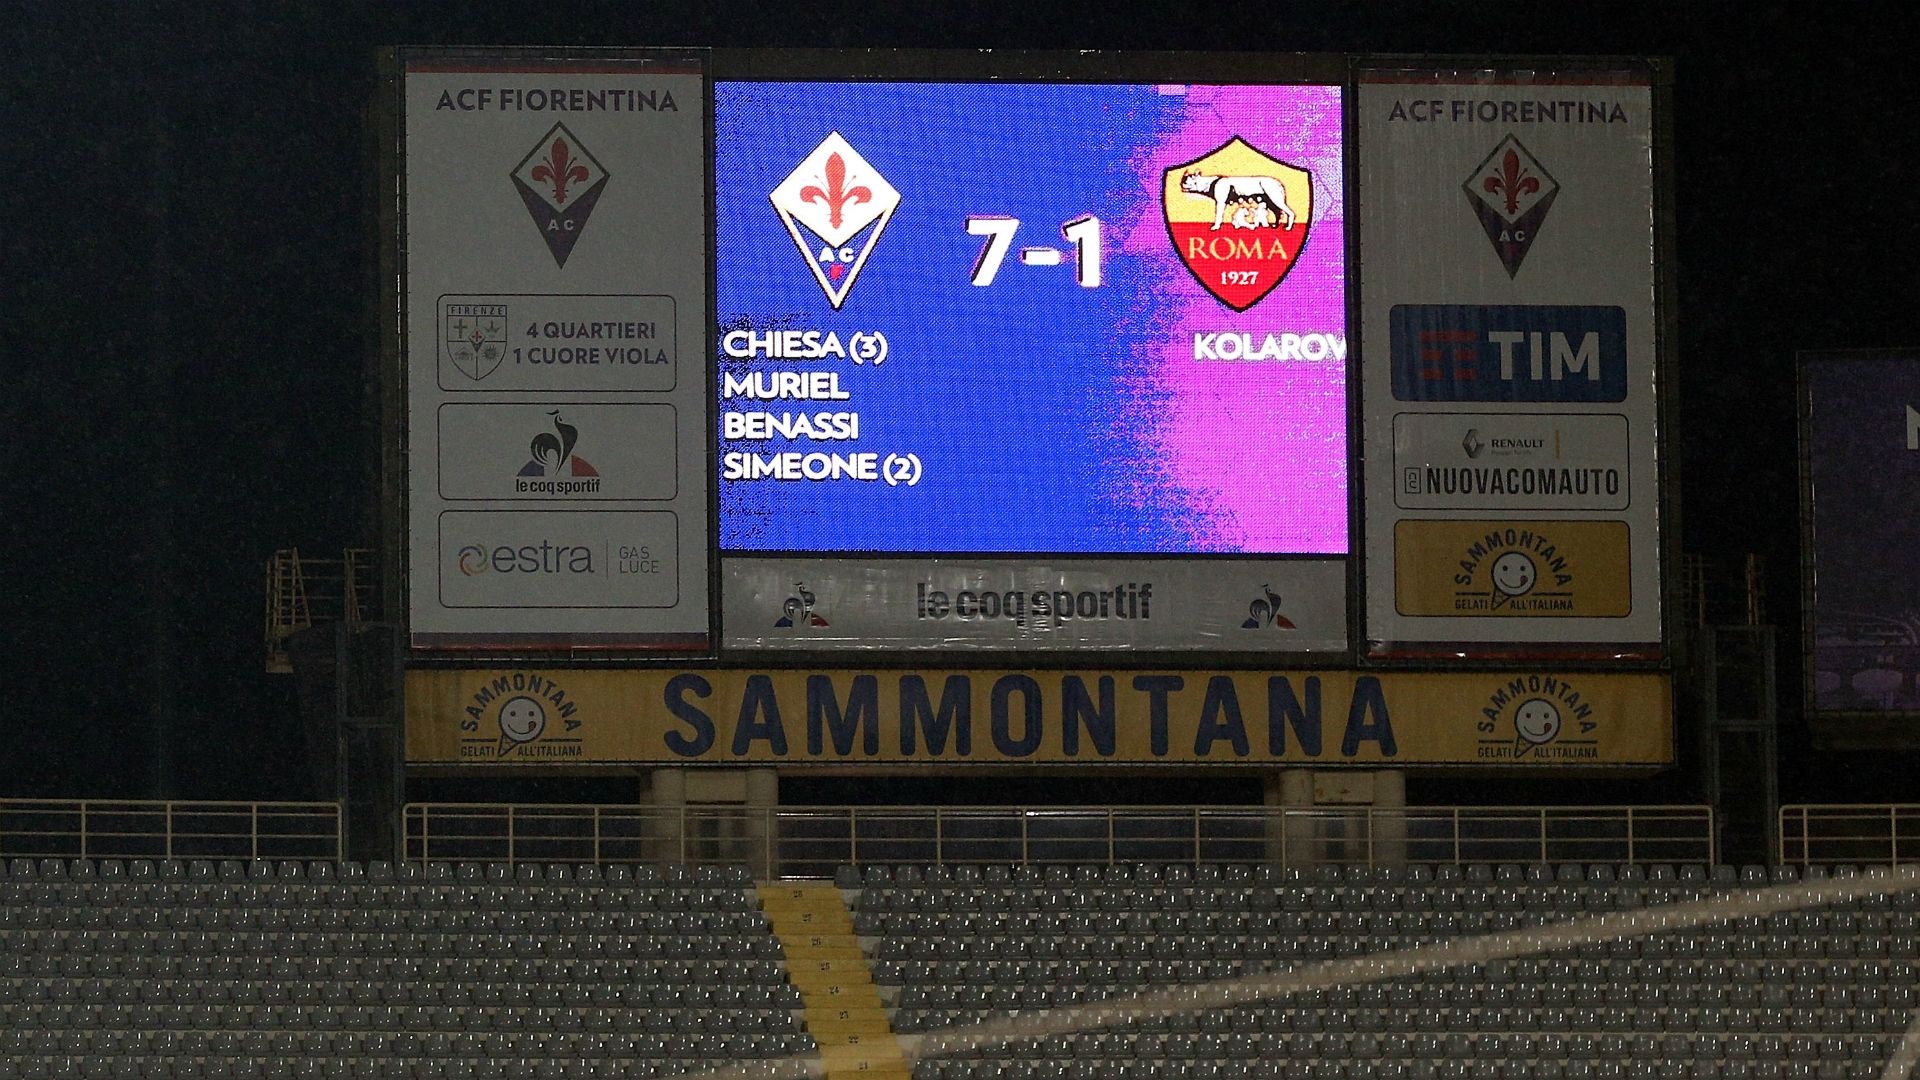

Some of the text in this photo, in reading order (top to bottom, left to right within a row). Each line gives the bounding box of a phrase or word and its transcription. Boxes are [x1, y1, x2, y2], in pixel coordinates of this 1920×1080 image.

[436, 89, 679, 112] ACF FIORENTINA
[1388, 100, 1628, 123] ACF FIORENTINA
[1188, 236, 1288, 261] ROMA
[1219, 271, 1259, 285] 1927
[451, 306, 503, 315] FIRENZE
[526, 322, 656, 340] 4 QUARTIERI
[513, 347, 669, 365] 1 CUORE VIOLA
[723, 330, 888, 365] CHIESA (3)
[1195, 332, 1347, 360] KOLAROV
[1488, 331, 1599, 381] TIM
[723, 371, 850, 400] MURIEL
[723, 412, 859, 440] BENASSI
[1491, 439, 1545, 449] RENAULT
[723, 452, 922, 487] SIMEONE (2)
[1427, 467, 1619, 496] NUOVACOMAUTO
[516, 478, 600, 495] le coq sportif
[492, 539, 595, 574] estra
[619, 546, 649, 560] GAS
[1454, 528, 1573, 586] SAMMONTANA
[619, 561, 660, 574] LUCE
[917, 583, 1152, 627] le coq sportif
[1455, 599, 1488, 611] GELATI
[461, 673, 582, 732] SAMMONTANA
[1477, 675, 1598, 734] SAMMONTANA
[664, 672, 1397, 760] SAMMONTANA
[461, 746, 495, 757] GELATI
[1478, 747, 1512, 758] GELATI
